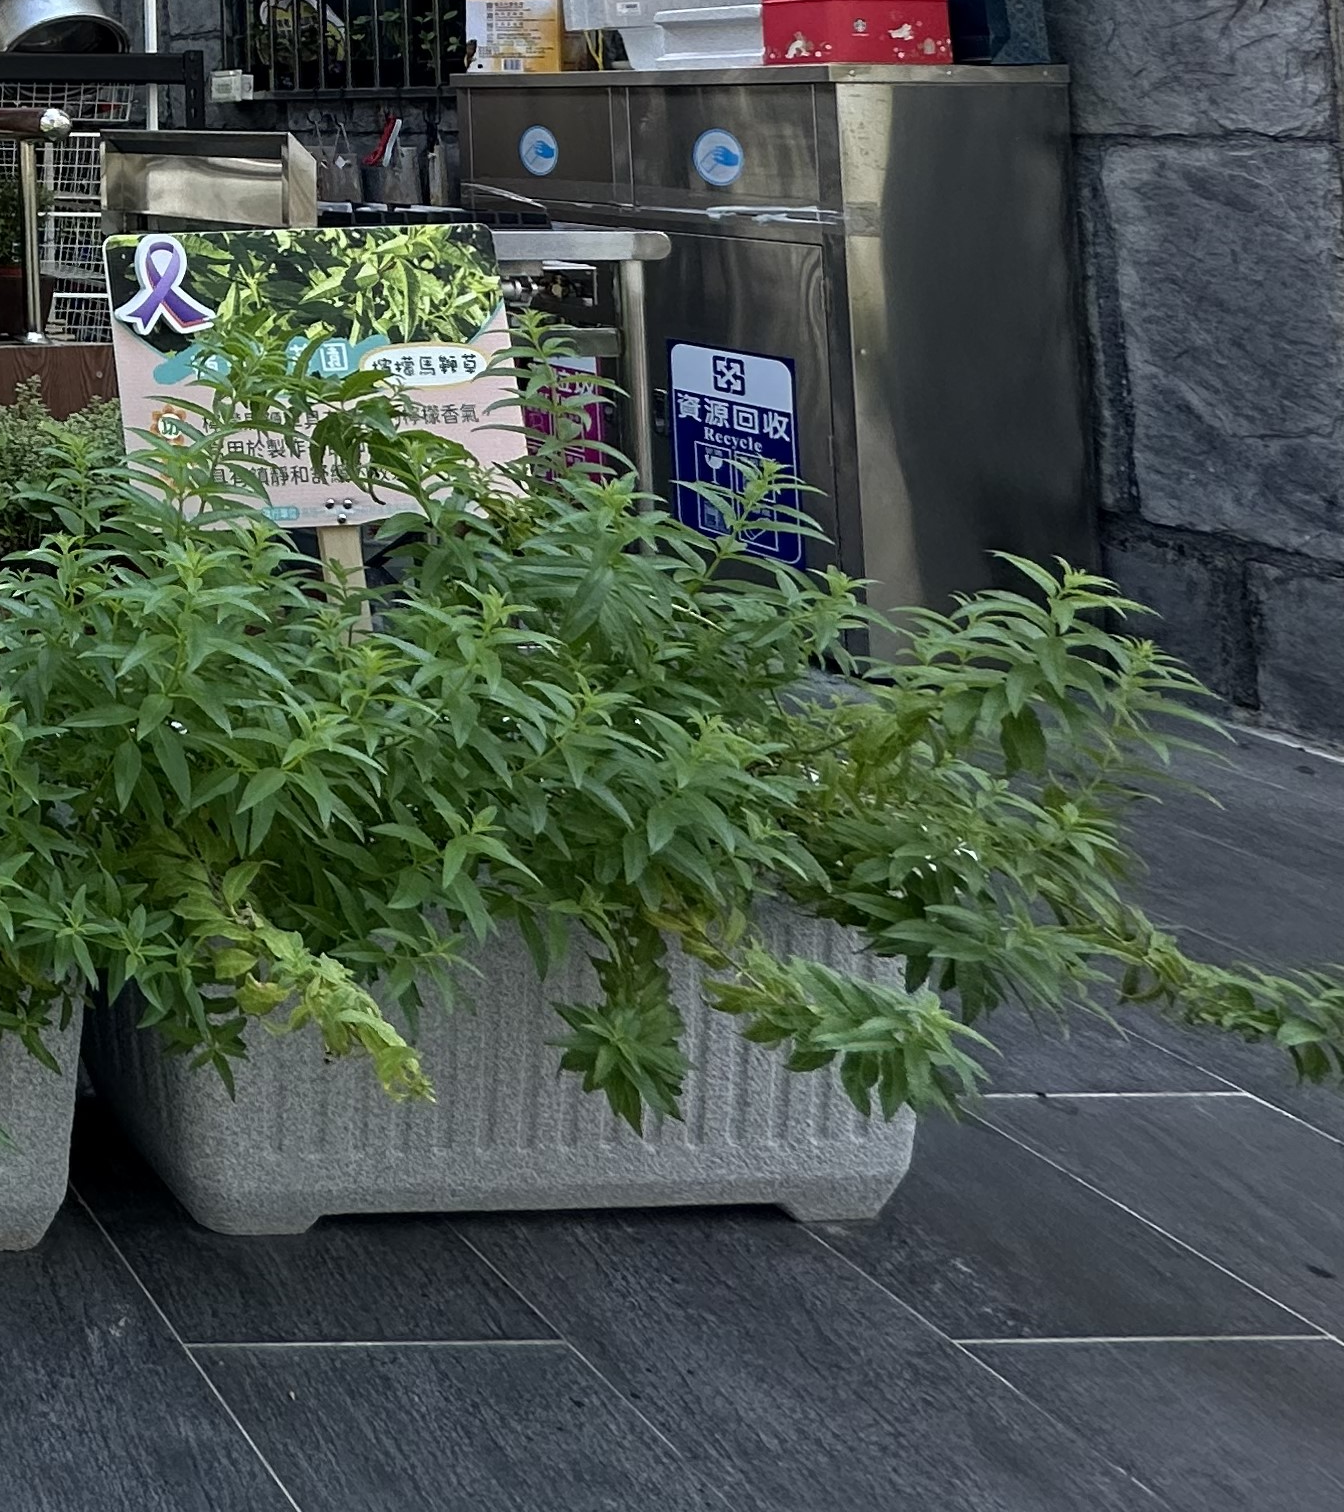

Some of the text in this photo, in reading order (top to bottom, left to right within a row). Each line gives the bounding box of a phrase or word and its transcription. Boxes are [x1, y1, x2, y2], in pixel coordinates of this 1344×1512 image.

[677, 392, 791, 442] 資源回收
[704, 426, 763, 453] Recycle
